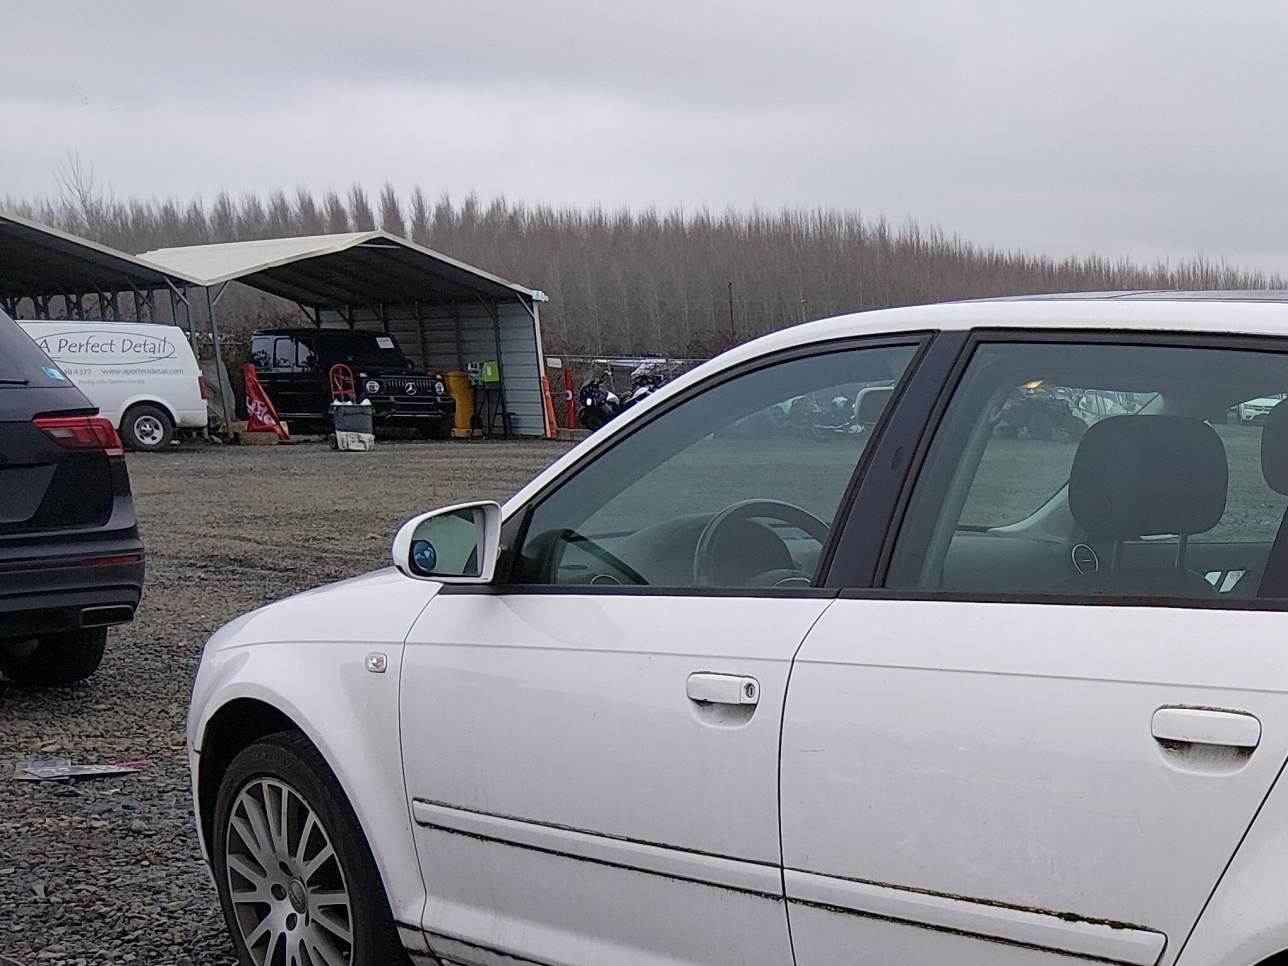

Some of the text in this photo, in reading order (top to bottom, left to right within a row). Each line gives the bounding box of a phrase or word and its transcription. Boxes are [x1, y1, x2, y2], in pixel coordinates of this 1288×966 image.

[39, 334, 167, 355] A Perfect Detail
